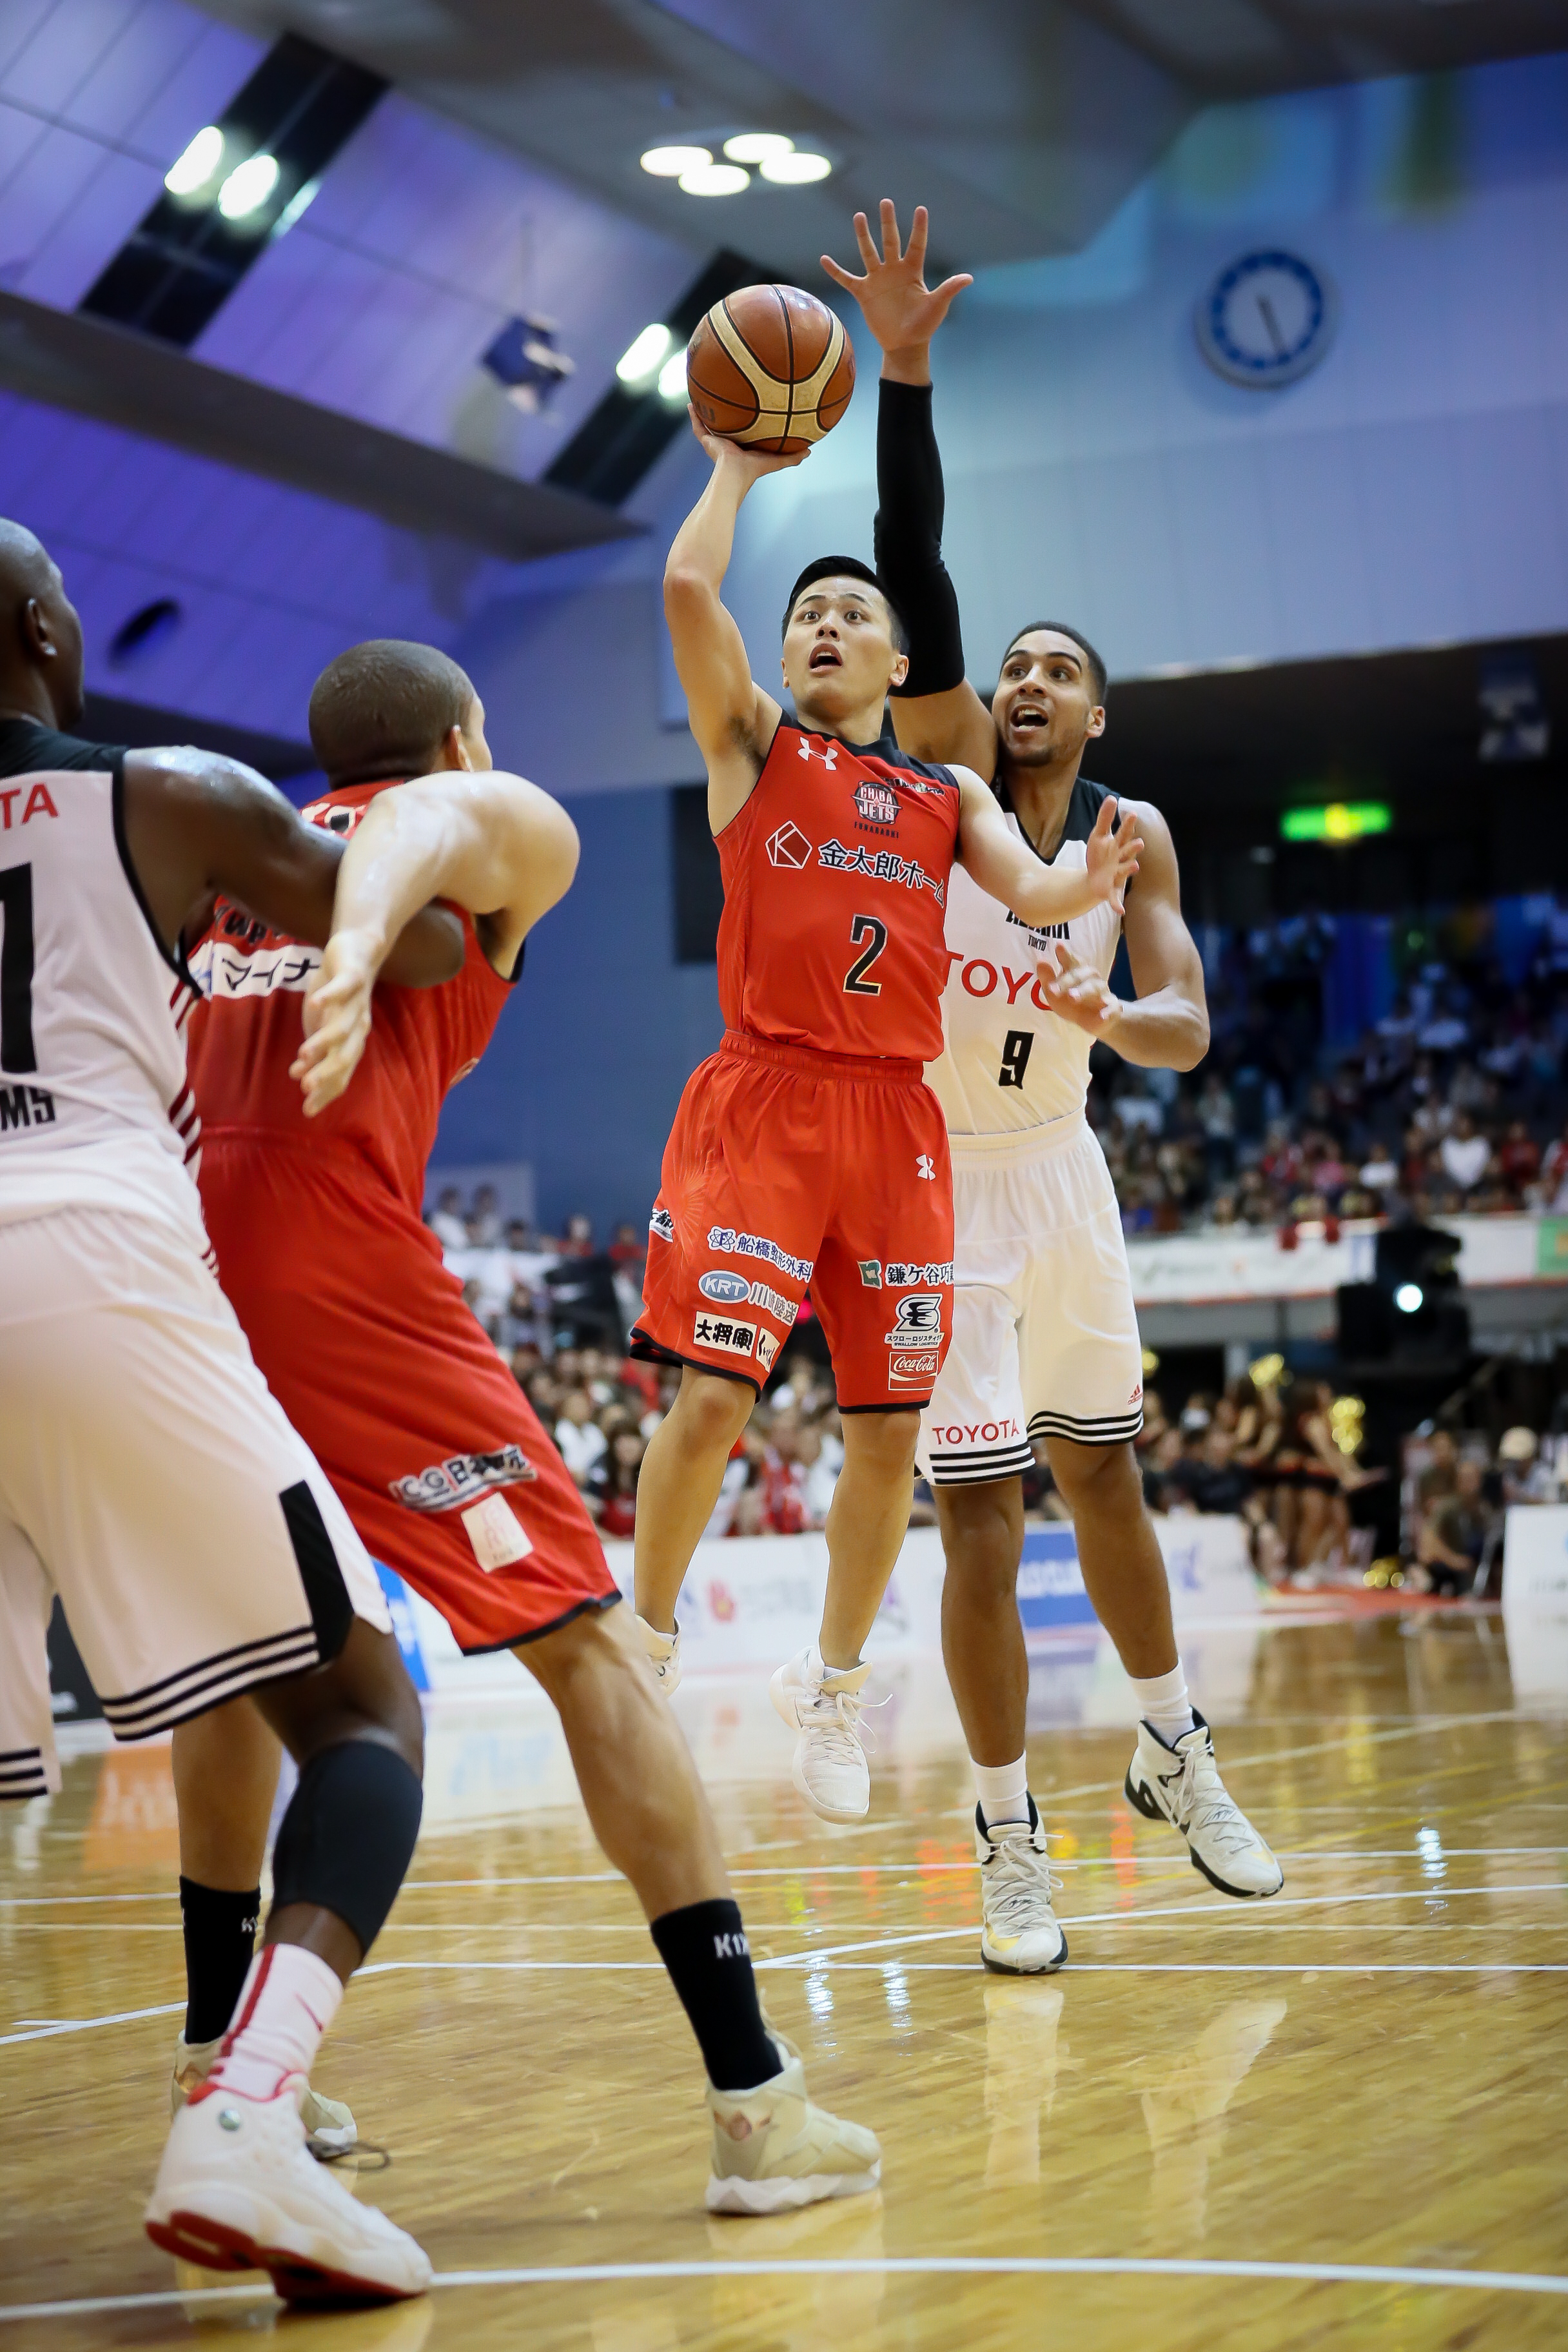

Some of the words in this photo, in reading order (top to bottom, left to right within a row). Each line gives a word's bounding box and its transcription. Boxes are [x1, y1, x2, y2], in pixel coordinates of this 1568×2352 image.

[0, 783, 59, 830] TA
[860, 787, 893, 805] CHIBA
[859, 799, 894, 821] JETS
[843, 914, 888, 996] 2
[1028, 934, 1047, 952] TOKYO
[999, 1030, 1035, 1090] 9
[705, 1277, 744, 1297] KRT
[932, 1418, 1019, 1445] TOYOTA
